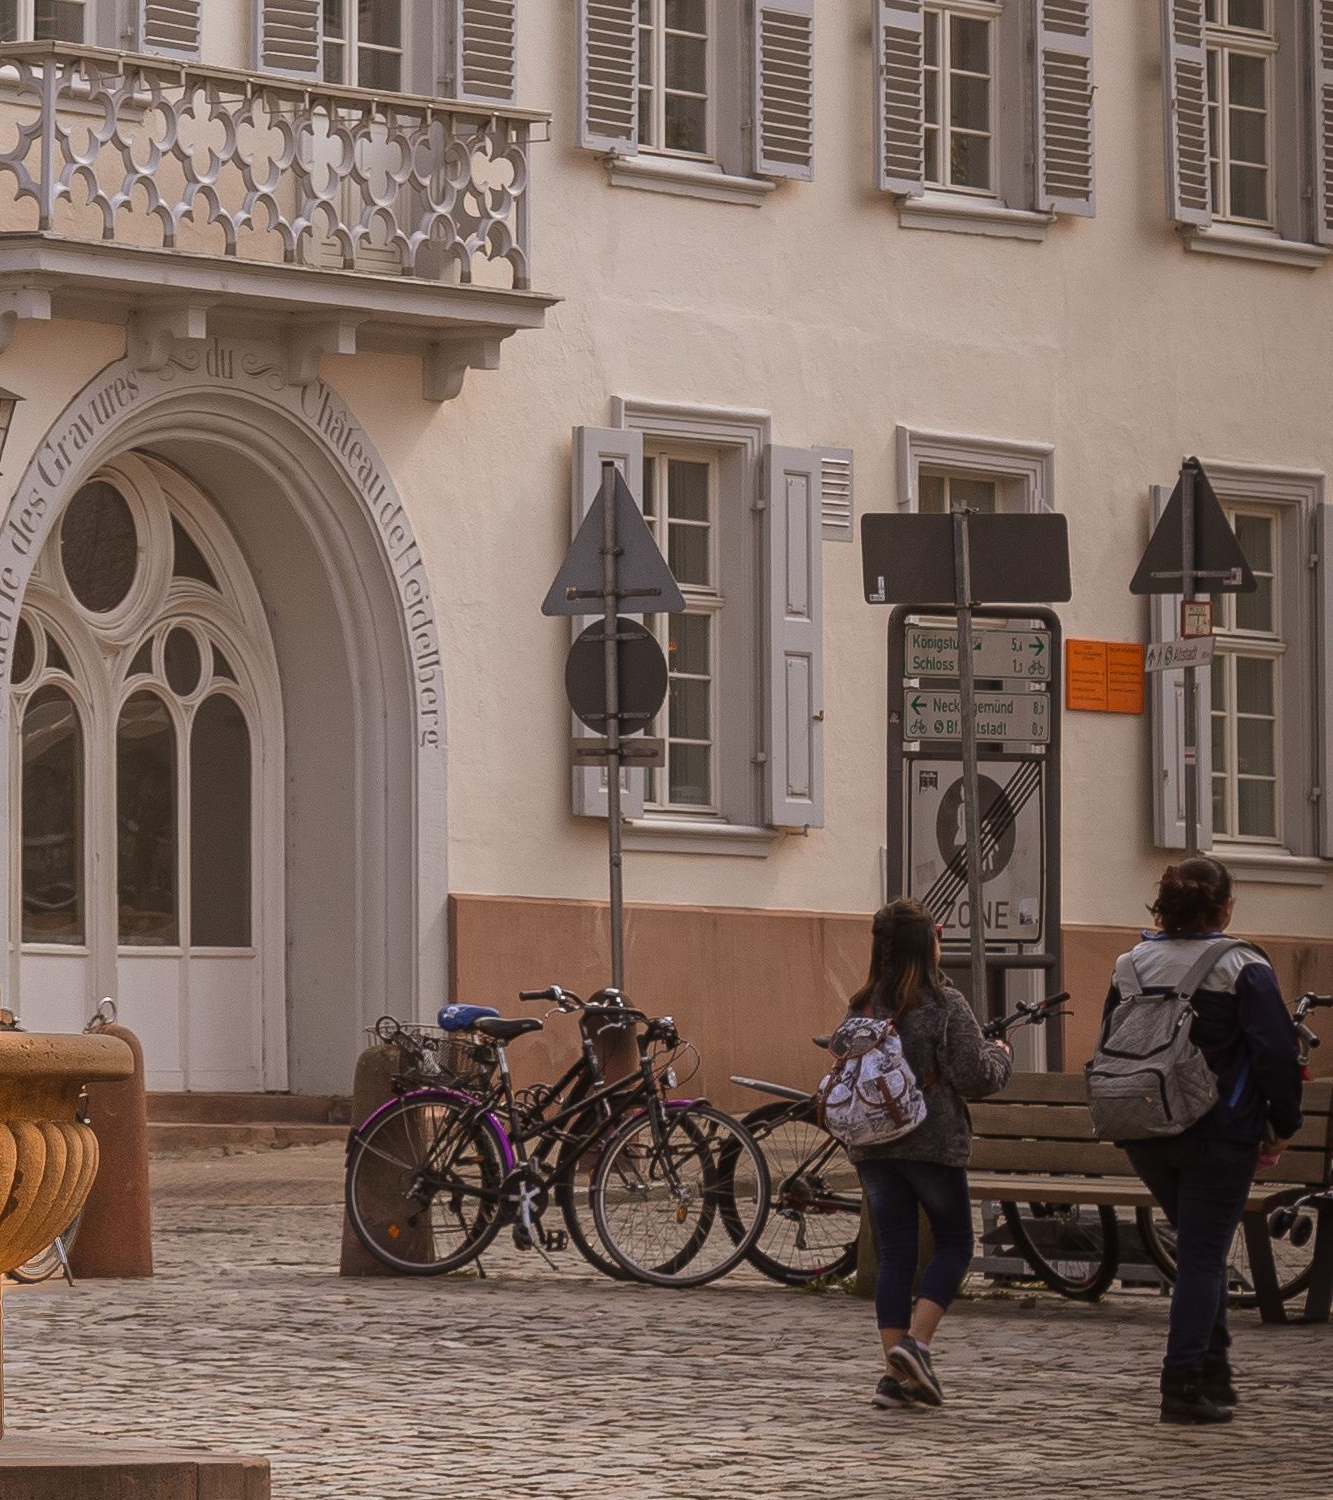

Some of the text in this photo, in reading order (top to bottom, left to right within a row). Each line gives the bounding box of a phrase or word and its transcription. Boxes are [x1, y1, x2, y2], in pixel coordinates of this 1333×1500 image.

[9, 488, 47, 555] des
[36, 370, 140, 488] Gravures
[205, 337, 234, 380] du
[380, 502, 406, 549] de
[394, 540, 441, 749] Heidelberg
[912, 634, 960, 653] Königstu
[913, 655, 954, 671] Schloss
[933, 697, 1014, 717] Neckgemünd
[976, 722, 1007, 736] tstadt
[943, 900, 1010, 930] ZONE
